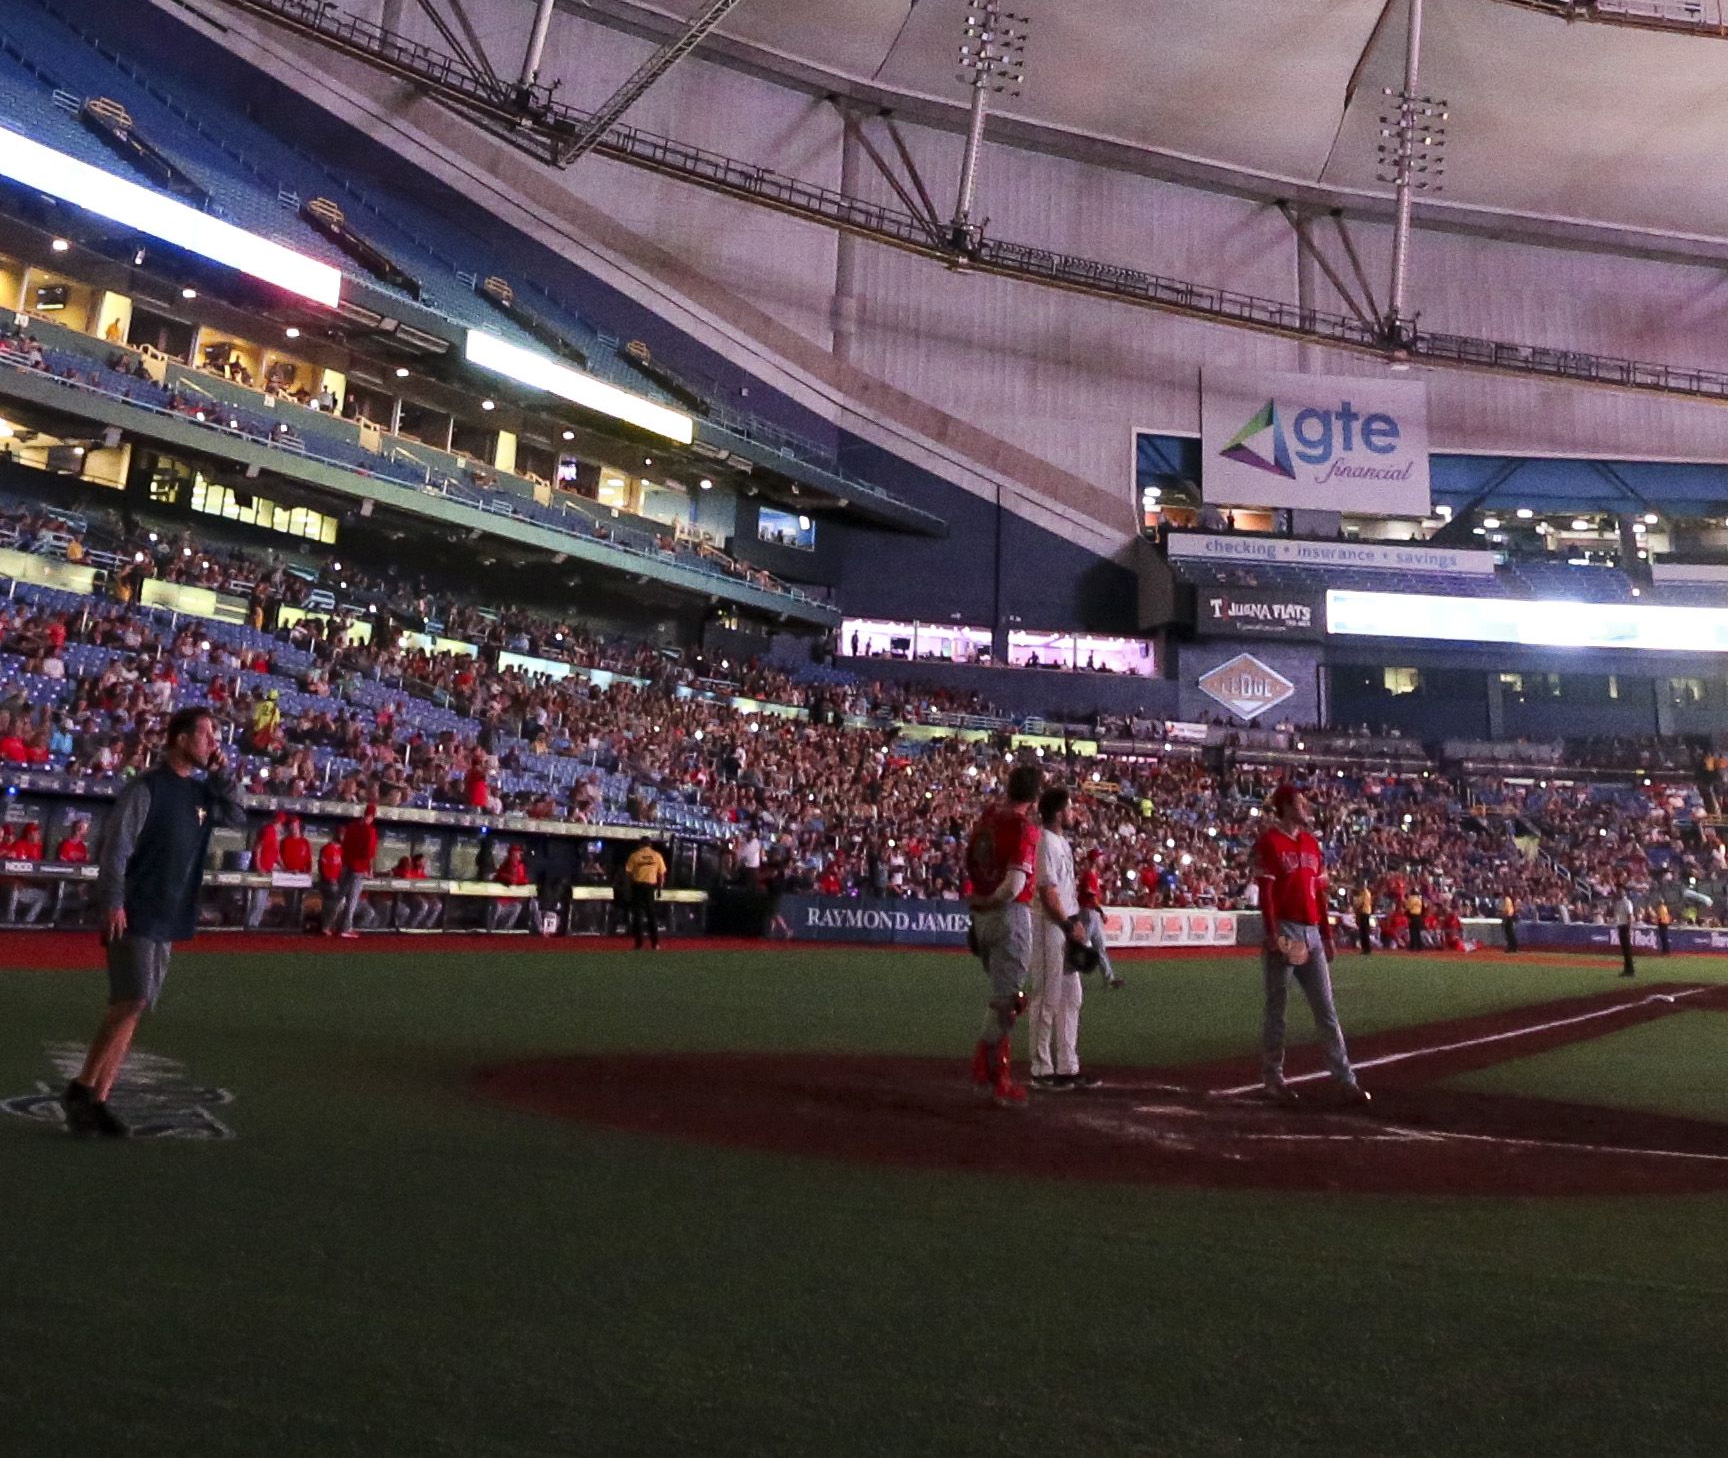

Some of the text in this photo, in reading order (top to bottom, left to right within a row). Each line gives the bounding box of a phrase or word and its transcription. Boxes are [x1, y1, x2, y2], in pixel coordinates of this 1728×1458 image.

[1292, 400, 1401, 465] gte
[1314, 458, 1415, 484] financial
[1205, 540, 1458, 567] checking insurance savings
[1272, 603, 1312, 620] FLATS
[806, 906, 972, 933] RAYMOND JAME
